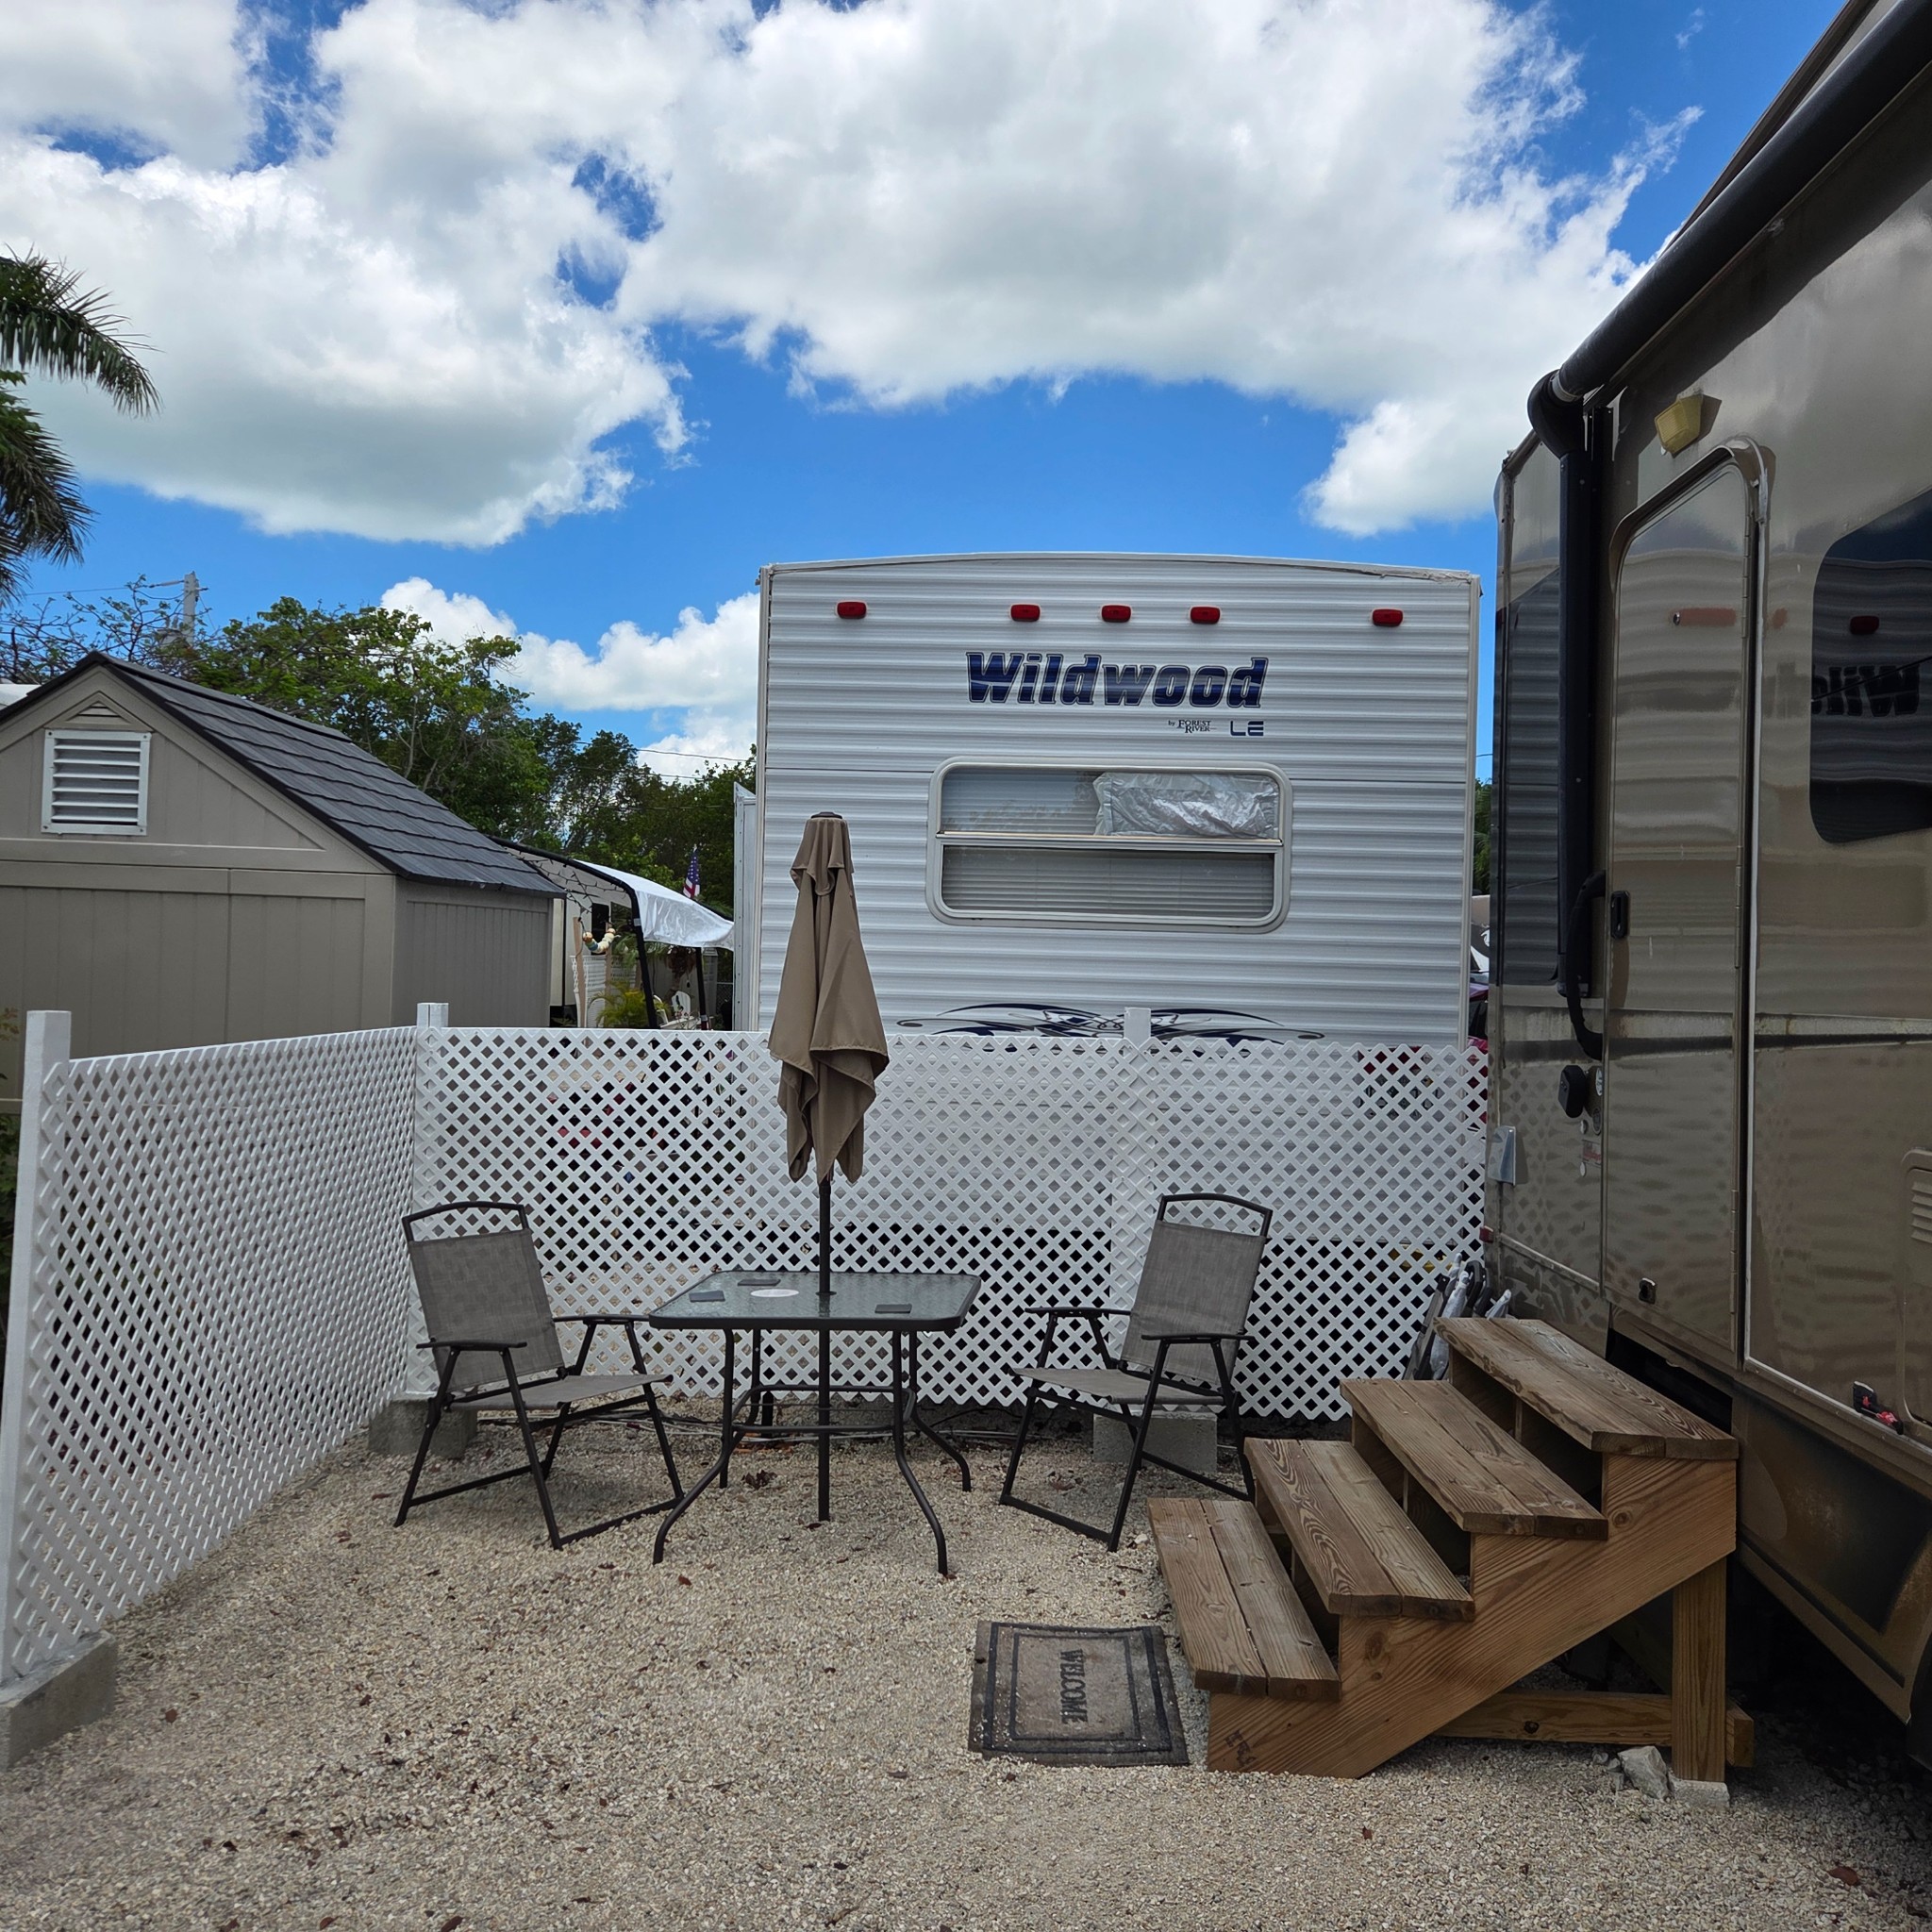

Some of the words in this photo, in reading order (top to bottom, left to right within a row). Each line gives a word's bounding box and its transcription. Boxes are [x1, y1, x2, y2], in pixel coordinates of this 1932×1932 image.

[965, 651, 1270, 708] Wildwood
[1176, 719, 1212, 729] FOREST
[1185, 725, 1211, 734] RIVER
[1230, 720, 1264, 737] LE
[1060, 1648, 1089, 1724] WELCOME
